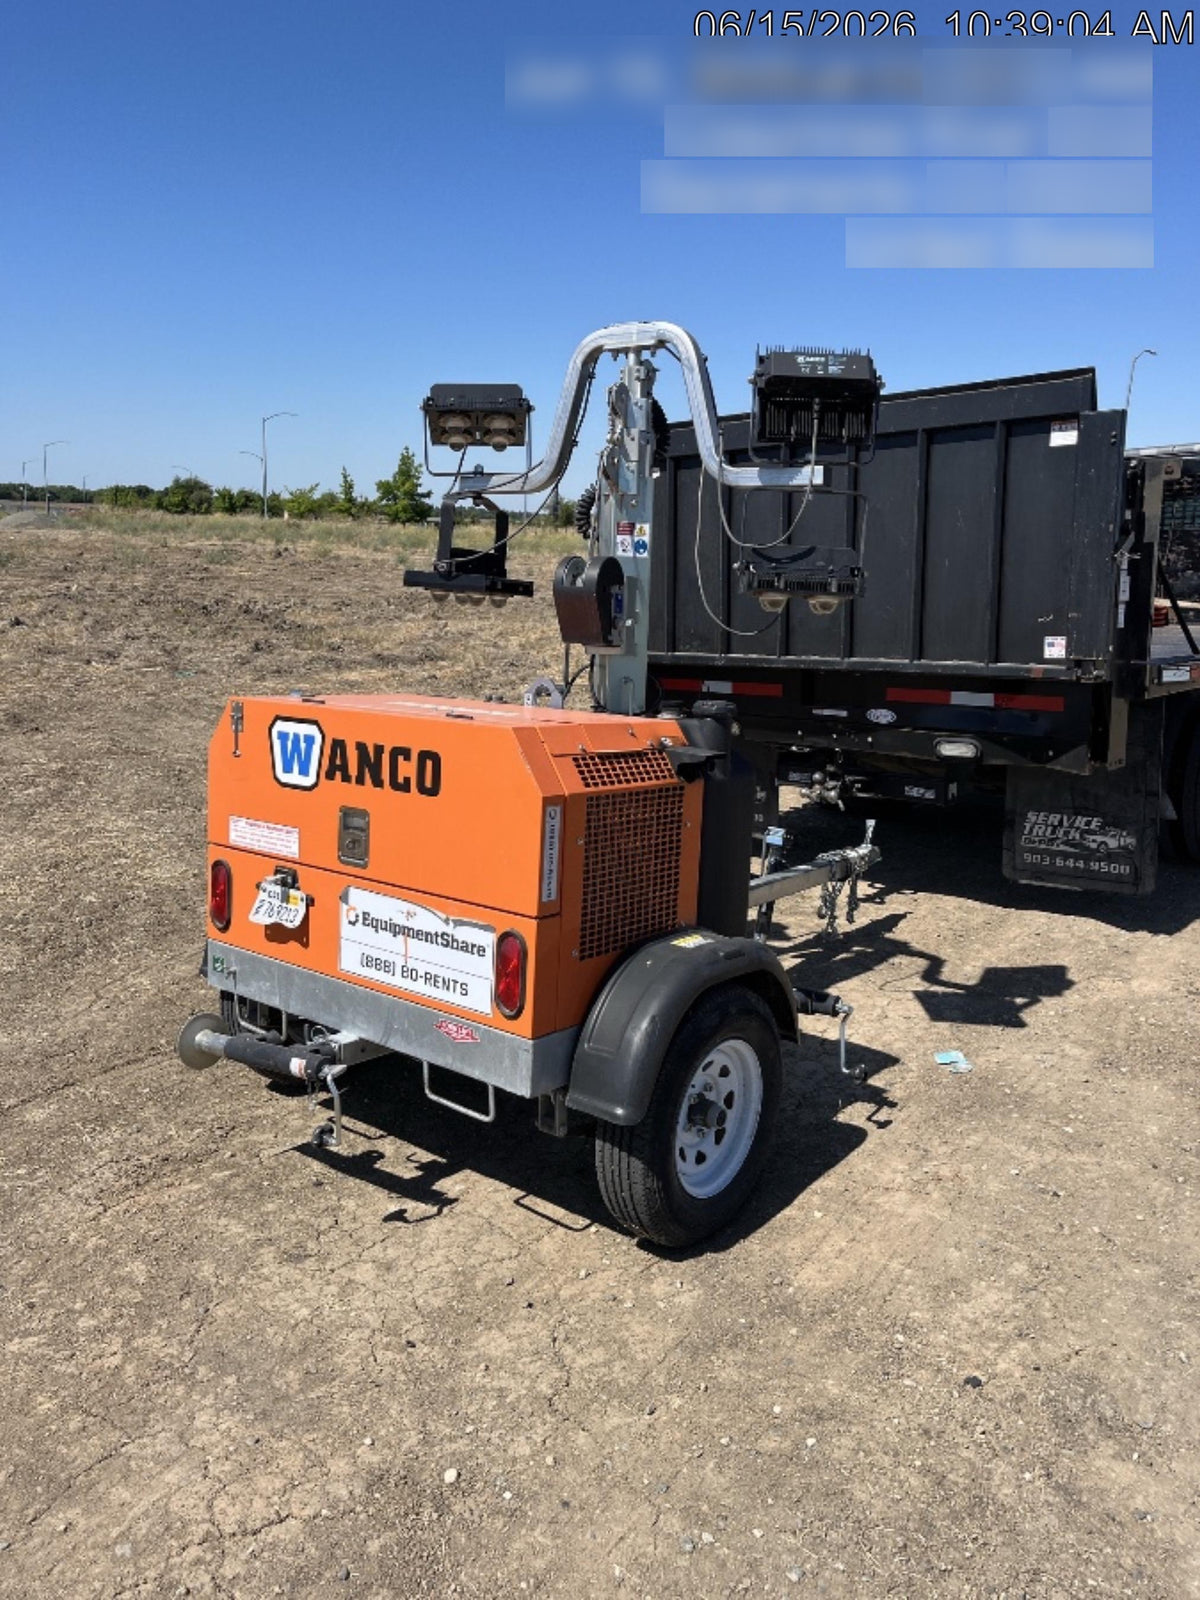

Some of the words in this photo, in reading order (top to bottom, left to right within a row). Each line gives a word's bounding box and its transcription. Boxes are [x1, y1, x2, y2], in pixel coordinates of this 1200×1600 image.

[275, 730, 442, 797] WANCO
[1023, 822, 1081, 840] TRUCK
[1025, 811, 1103, 829] SERVICE
[361, 911, 487, 958] EquipmentShare
[400, 964, 469, 997] 80-RENTS
